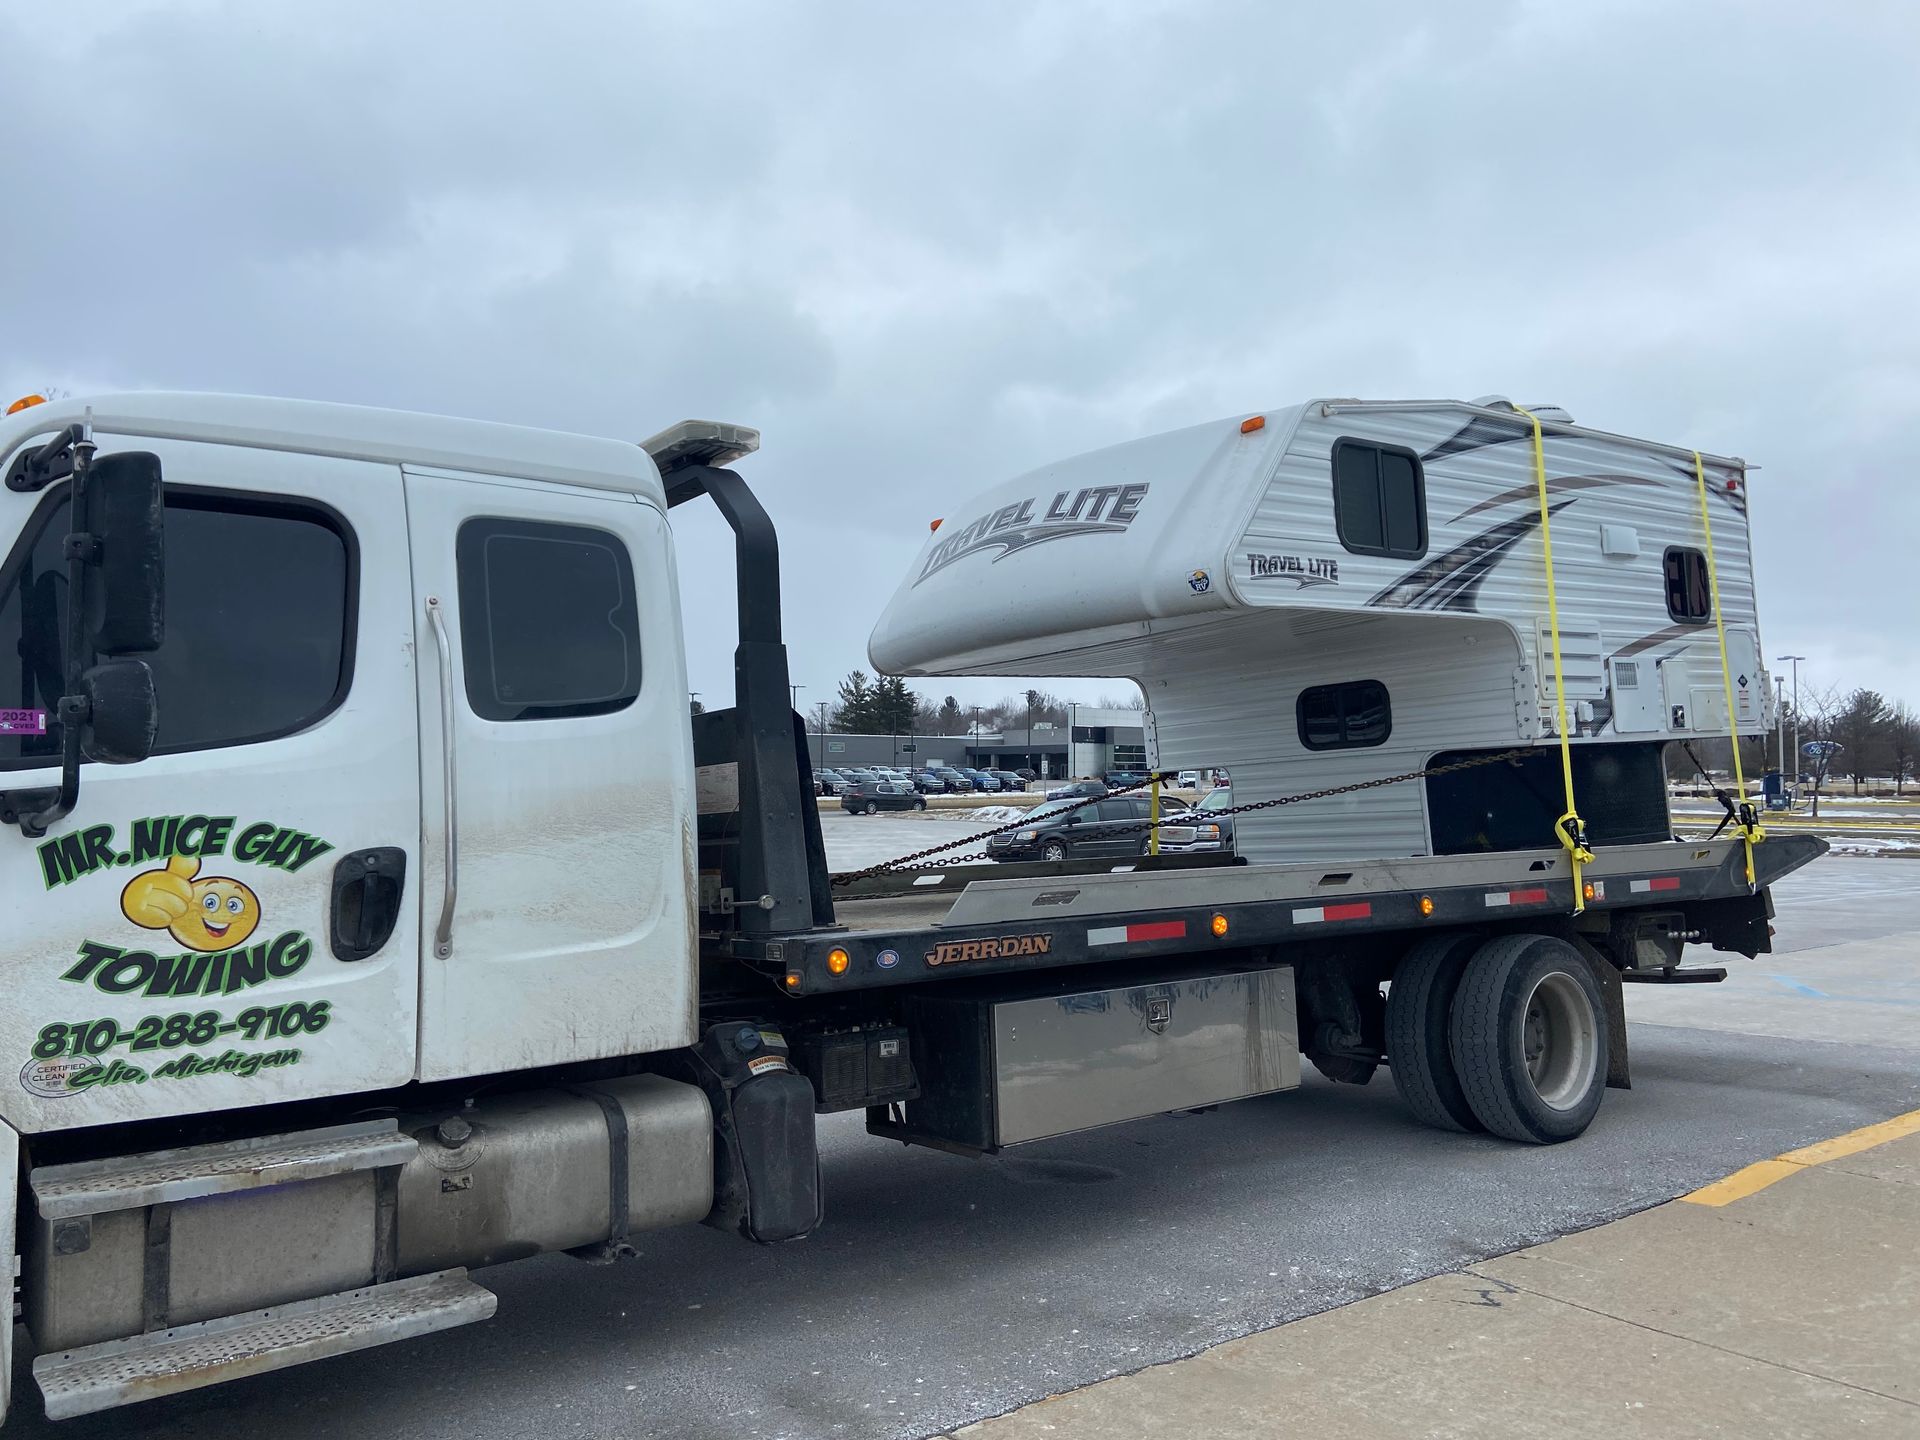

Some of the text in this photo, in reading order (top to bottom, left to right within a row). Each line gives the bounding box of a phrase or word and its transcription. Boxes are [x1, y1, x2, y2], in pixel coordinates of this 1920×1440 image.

[919, 482, 1150, 579] TRAVEL LITE
[1247, 553, 1339, 581] TRAVEL LITE
[2, 712, 34, 721] 2021
[130, 815, 237, 866] NICE
[232, 821, 336, 873] GUY
[59, 930, 313, 998] TOWING
[31, 1000, 332, 1060] 810-288-9106
[32, 1073, 65, 1082] CLEAN
[37, 1063, 86, 1074] CERTIFIED
[65, 1049, 302, 1091] Clio, Michigan
